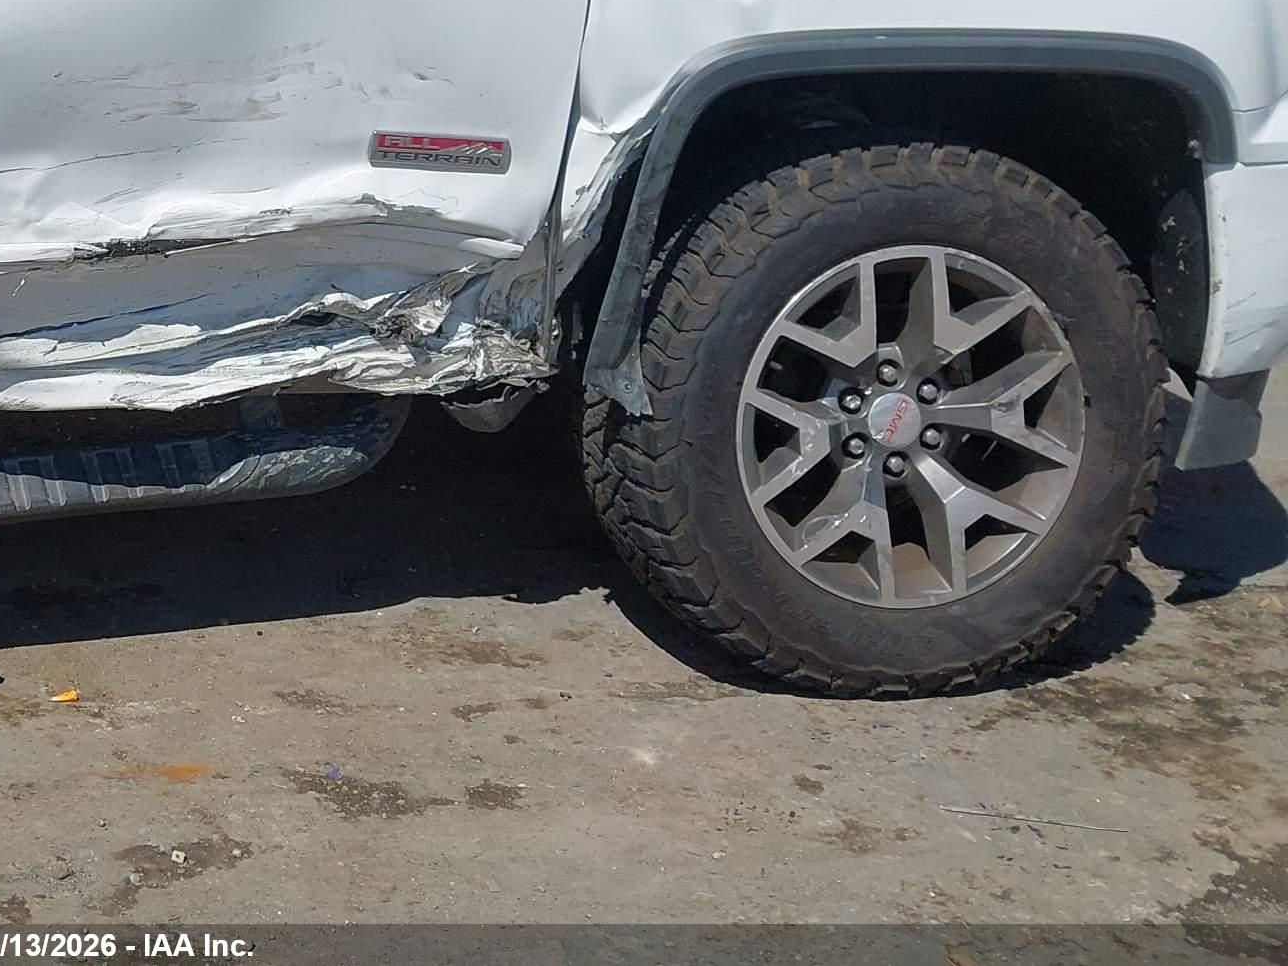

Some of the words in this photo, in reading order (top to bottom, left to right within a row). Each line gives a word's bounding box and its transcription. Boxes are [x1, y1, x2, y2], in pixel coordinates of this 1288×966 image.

[384, 135, 440, 150] ALL
[378, 151, 503, 167] TERRAIN
[882, 397, 909, 443] GMC
